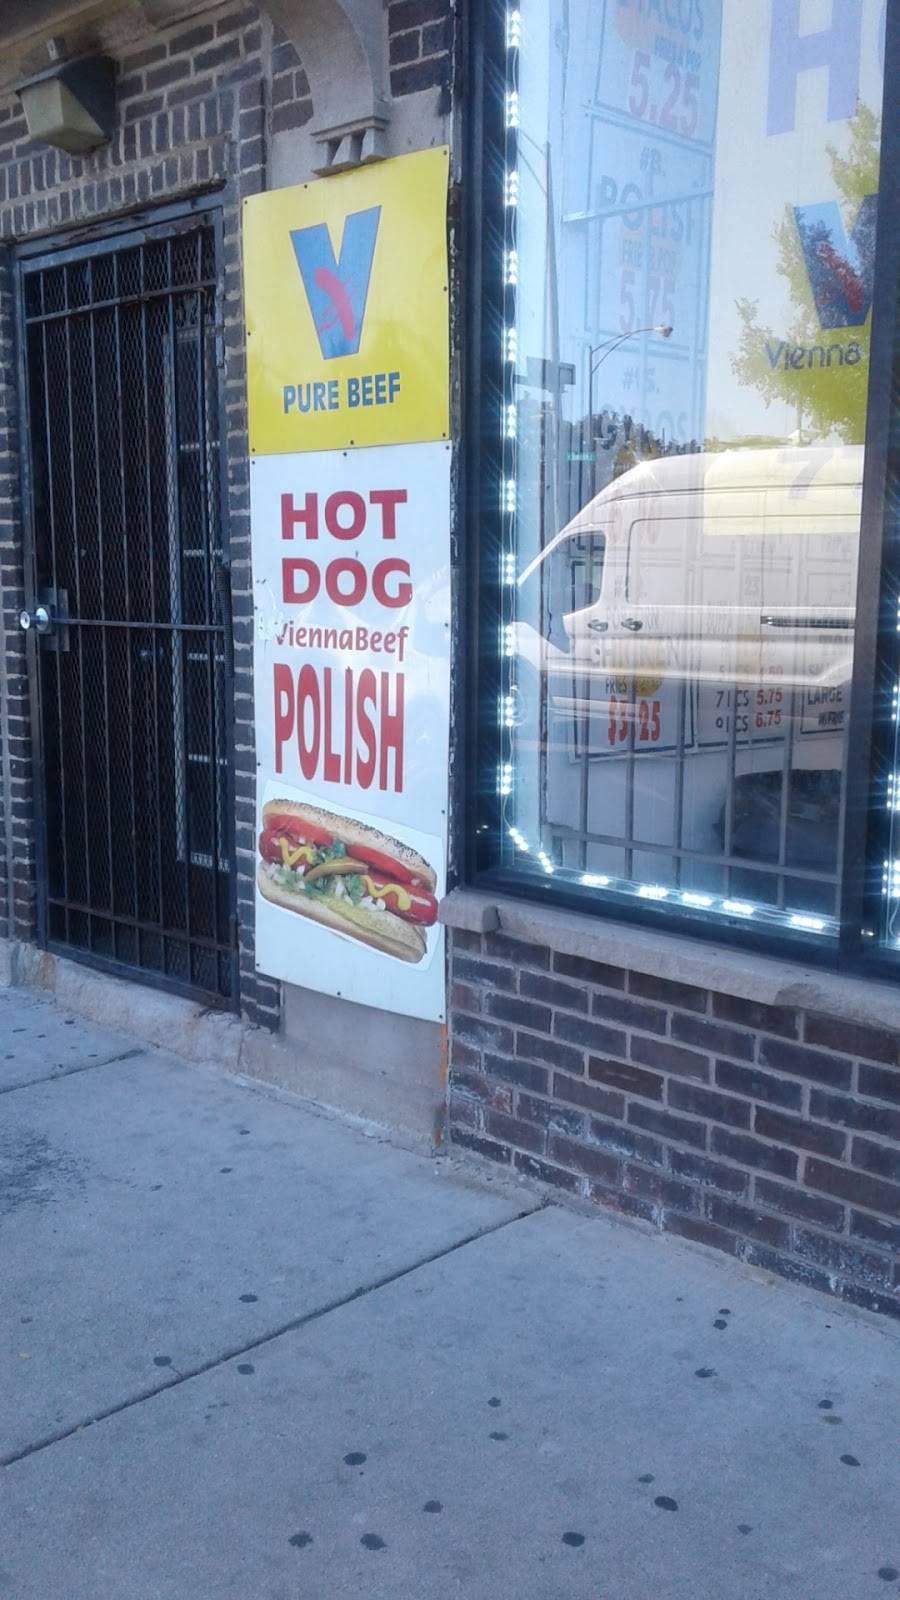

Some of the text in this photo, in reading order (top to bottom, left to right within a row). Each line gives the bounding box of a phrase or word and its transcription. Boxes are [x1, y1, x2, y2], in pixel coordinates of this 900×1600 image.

[289, 205, 382, 360] V
[765, 338, 861, 370] Vienna
[284, 372, 400, 414] PURE BEEF
[281, 489, 408, 540] HOT
[282, 558, 414, 608] DOG
[755, 710, 782, 728] 6.75
[756, 687, 783, 705] 5.75
[273, 663, 404, 793] POLISH
